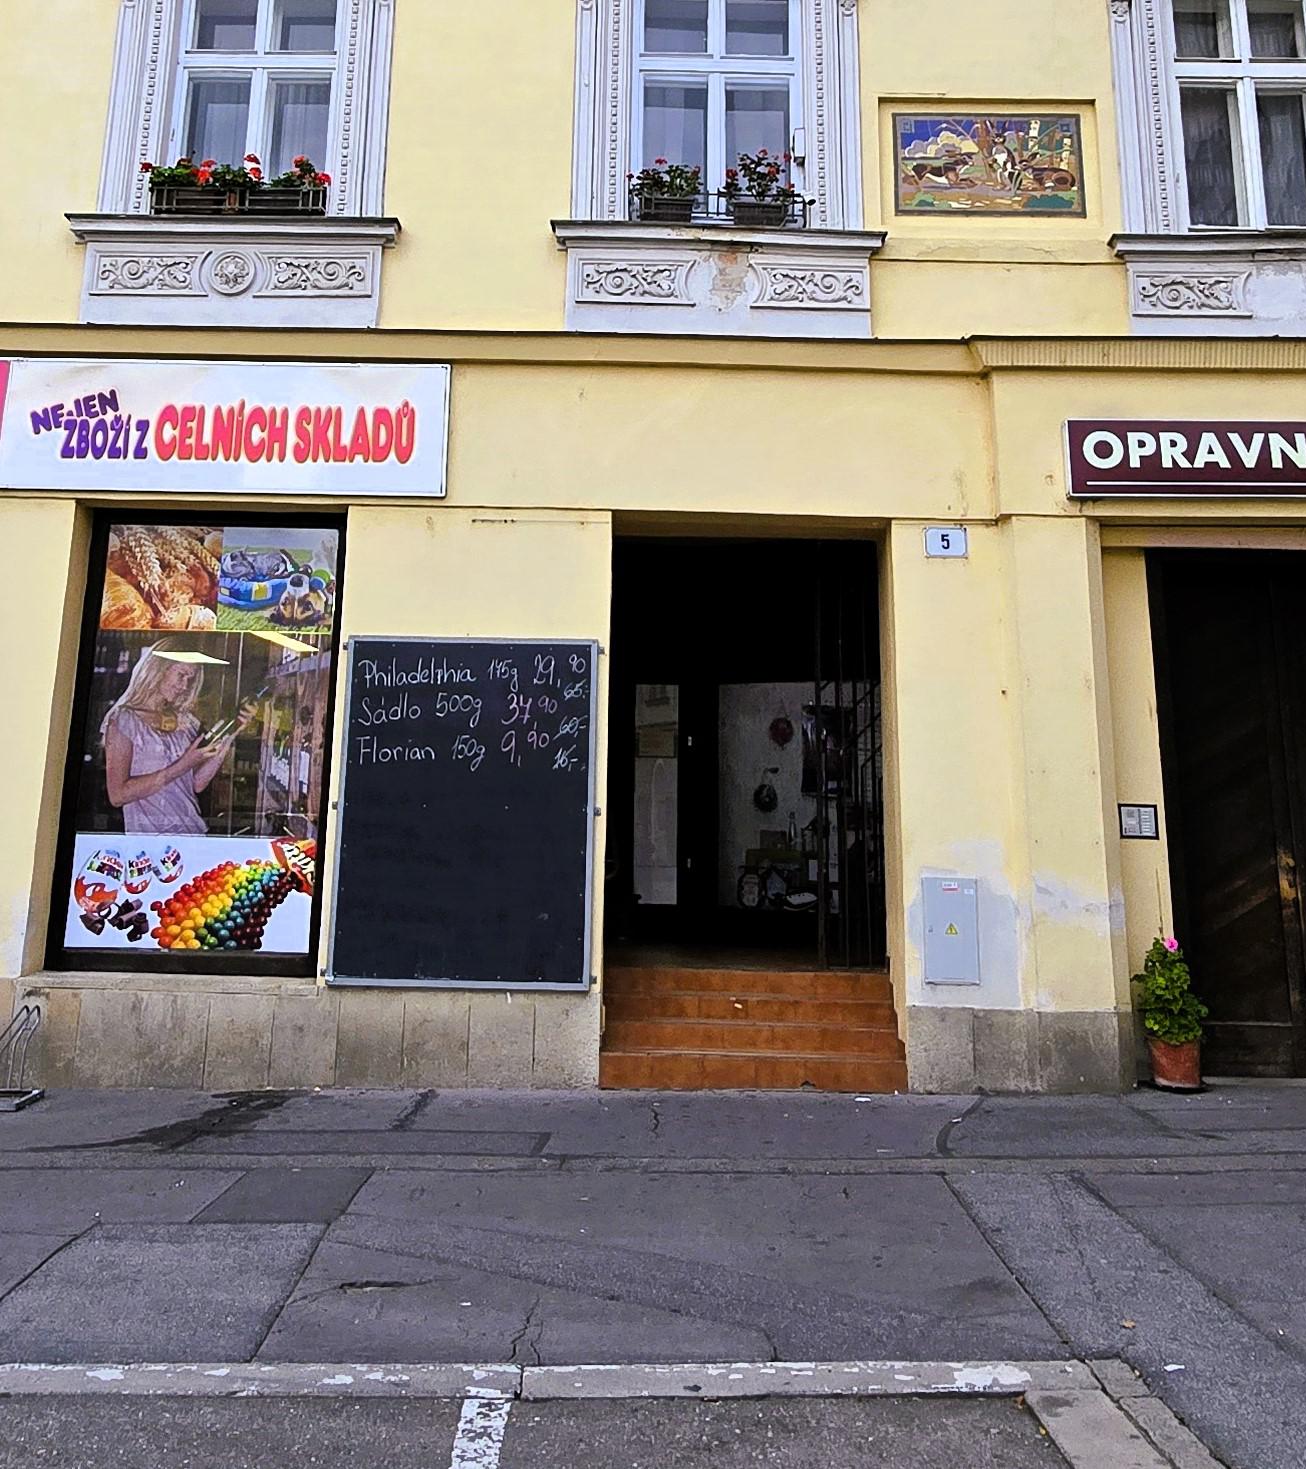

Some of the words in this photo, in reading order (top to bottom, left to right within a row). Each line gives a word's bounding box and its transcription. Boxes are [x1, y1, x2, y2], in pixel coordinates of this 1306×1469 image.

[61, 414, 131, 460] ZBOŽÍ
[133, 419, 150, 459] Z
[155, 399, 287, 462] CELNÍCH
[294, 400, 416, 465] SKLADŮ
[941, 533, 950, 550] 5
[358, 692, 421, 725] Sádlo
[435, 692, 482, 728] 500g
[355, 735, 436, 764] Florian
[452, 735, 485, 772] 150g
